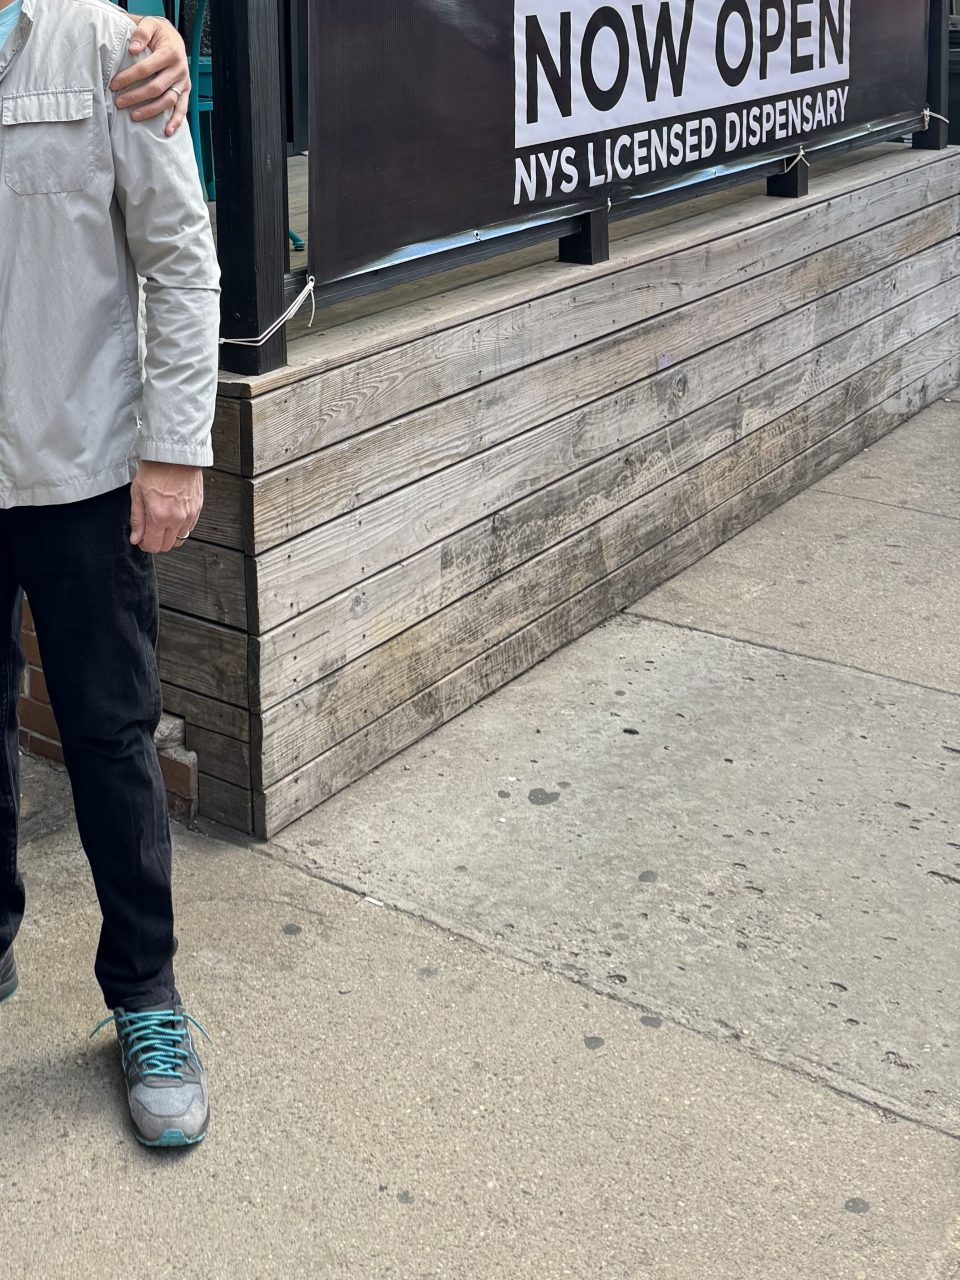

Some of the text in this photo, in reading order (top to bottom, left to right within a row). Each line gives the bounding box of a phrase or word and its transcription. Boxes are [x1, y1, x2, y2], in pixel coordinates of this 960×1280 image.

[526, 0, 694, 124] NOW
[514, 86, 849, 205] NYS LICENSED DISPENSARY
